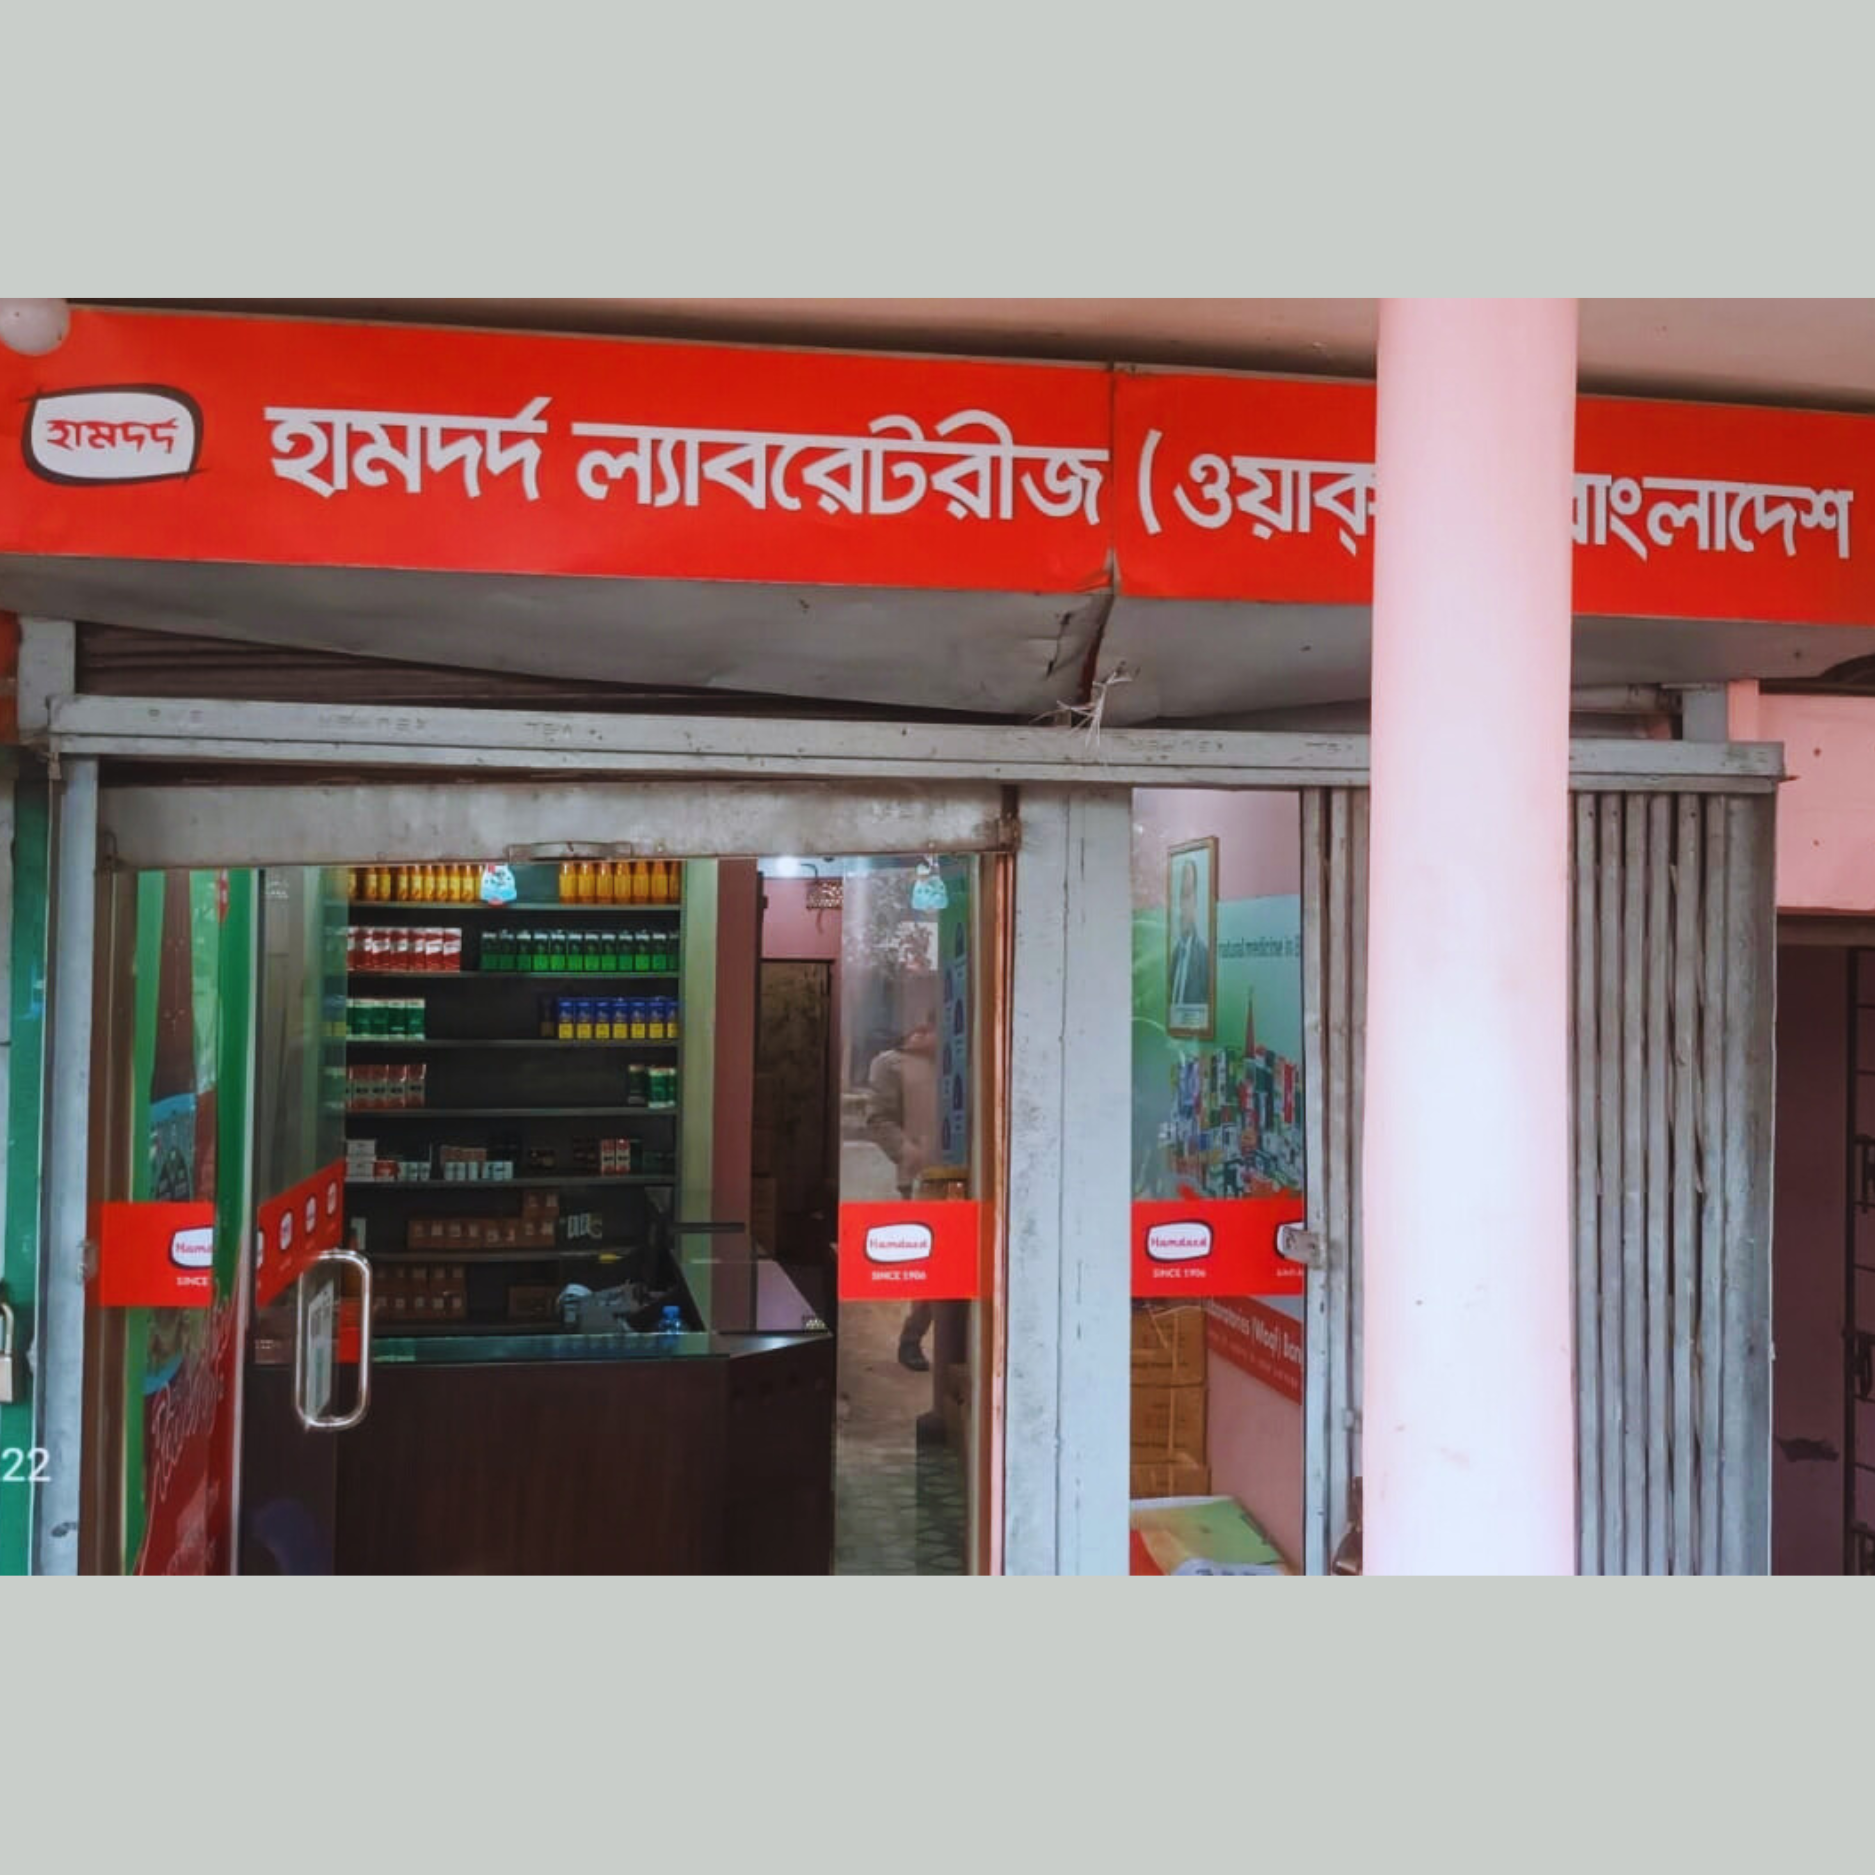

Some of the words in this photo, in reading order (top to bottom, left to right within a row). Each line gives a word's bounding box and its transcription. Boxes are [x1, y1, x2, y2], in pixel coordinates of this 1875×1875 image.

[46, 417, 178, 454] হামদর্দ
[264, 396, 552, 501] হামদর্দ
[571, 409, 1109, 525] ল্যাবরেটরীজ
[871, 1270, 901, 1281] SINCE
[1152, 1268, 1181, 1279] SINCE
